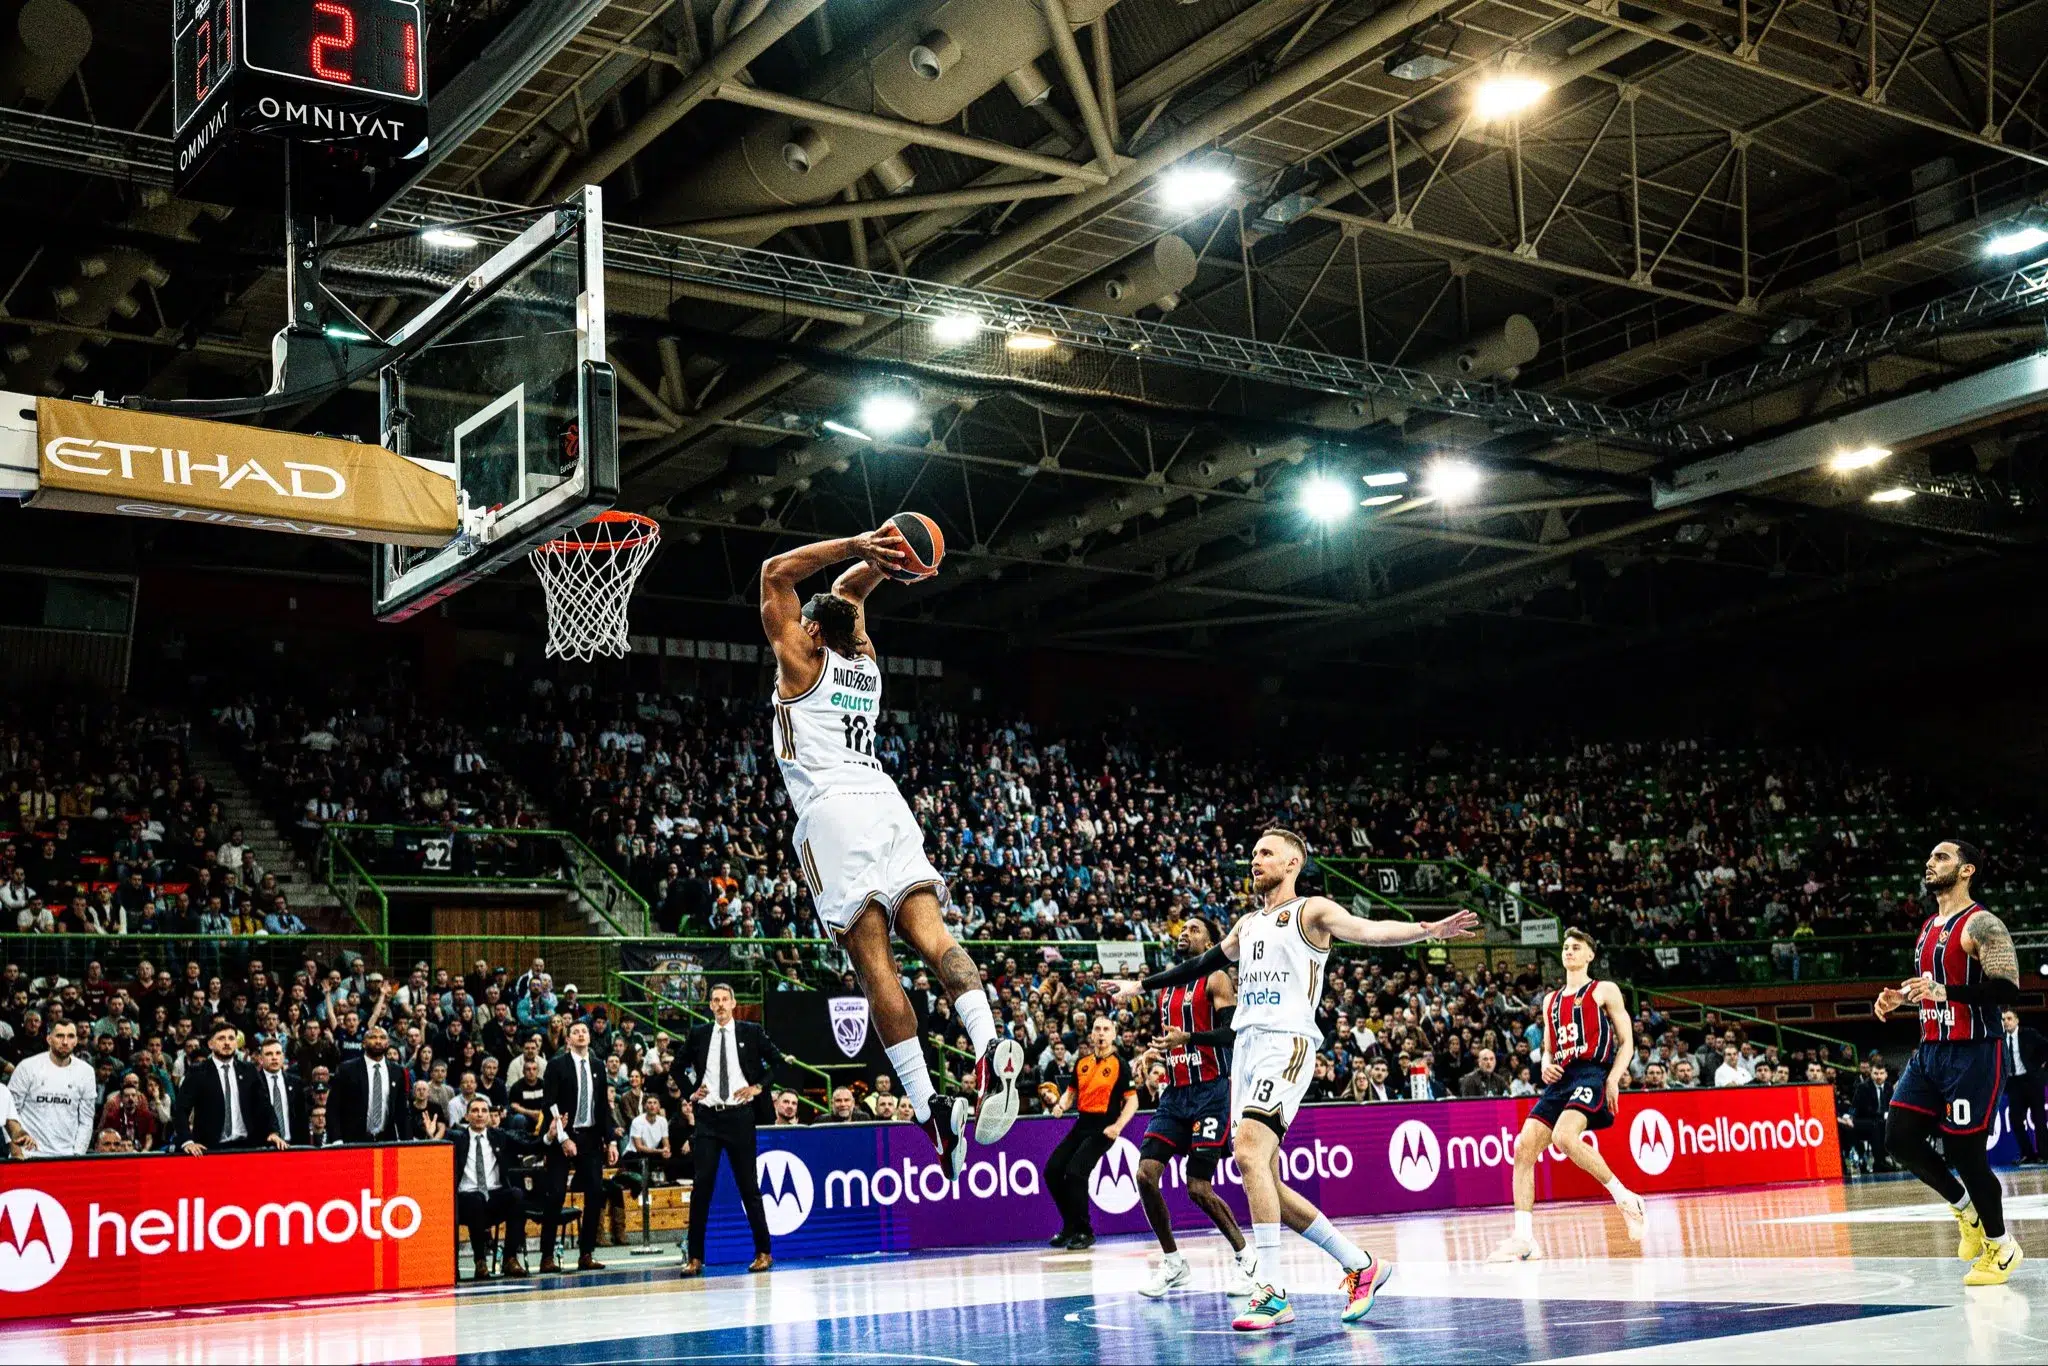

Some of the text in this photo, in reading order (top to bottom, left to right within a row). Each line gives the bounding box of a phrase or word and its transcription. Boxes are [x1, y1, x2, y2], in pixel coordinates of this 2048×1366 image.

[258, 97, 404, 141] OMNIYAT
[180, 101, 228, 171] OMNIYAT
[45, 436, 346, 500] ETIHAD
[115, 504, 357, 536] ETIHAD
[1504, 902, 1516, 920] E
[1252, 940, 1265, 961] 13
[36, 1095, 72, 1106] DUBAI
[1252, 1078, 1274, 1103] 13
[1569, 1086, 1593, 1103] 93
[1952, 1098, 1971, 1126] 0
[1202, 1116, 1219, 1140] 2
[1677, 1112, 1824, 1156] hellomoto
[824, 1151, 1040, 1209] motorola
[88, 1188, 422, 1259] hellomoto
